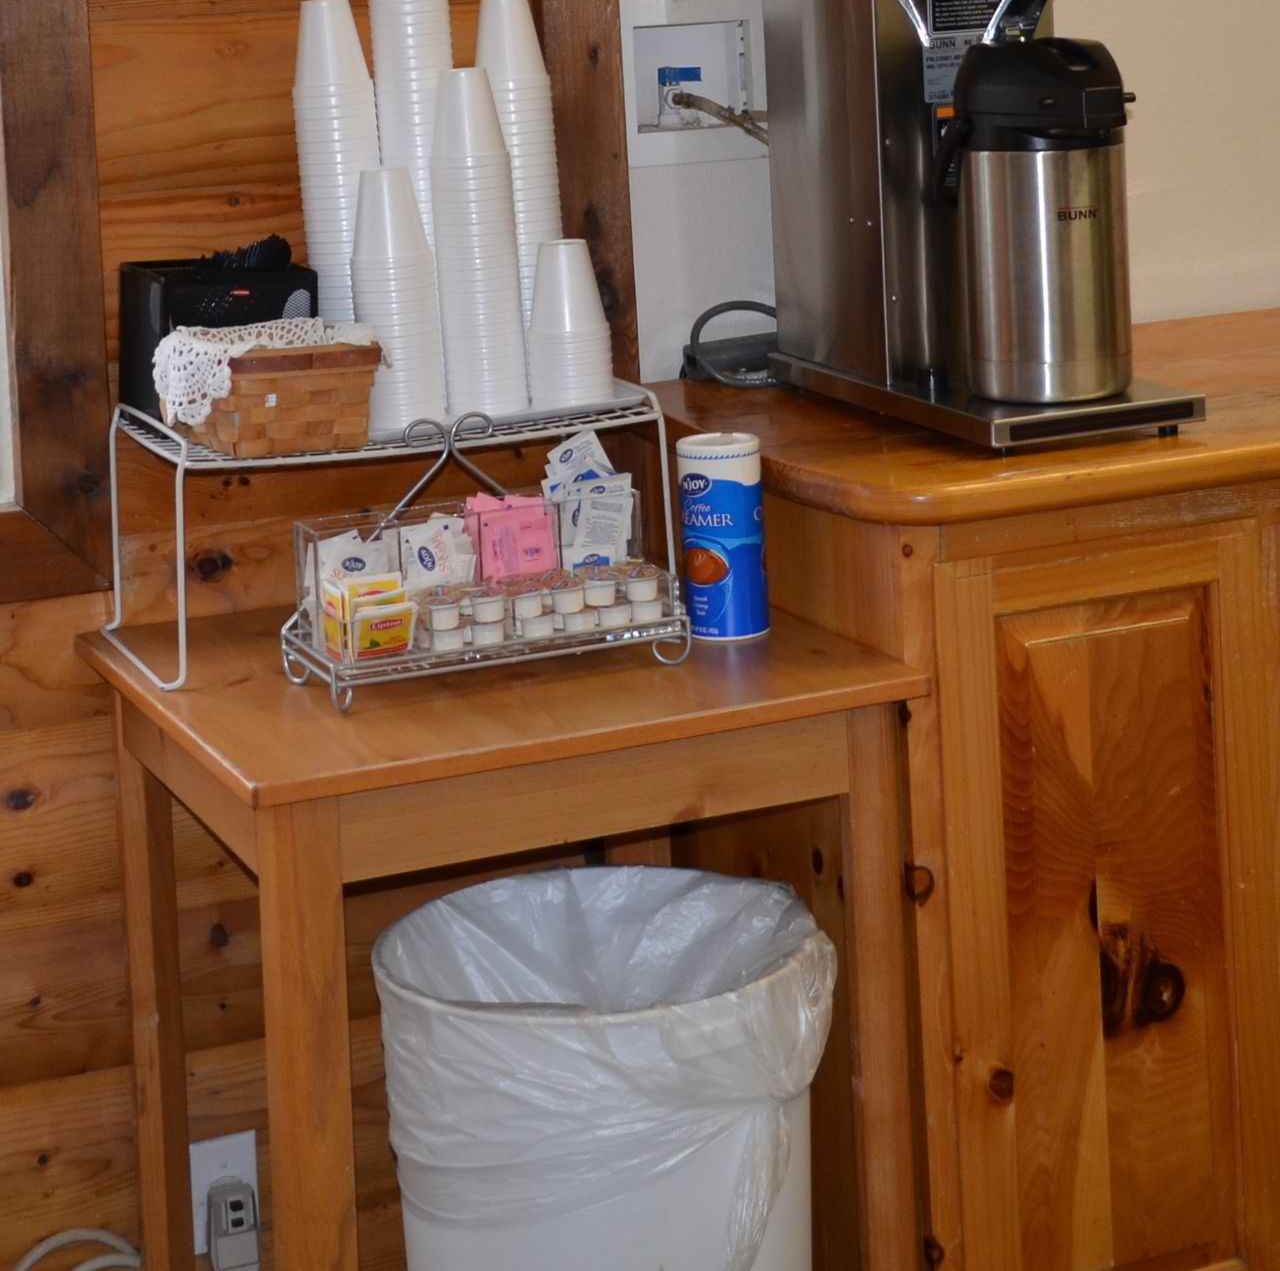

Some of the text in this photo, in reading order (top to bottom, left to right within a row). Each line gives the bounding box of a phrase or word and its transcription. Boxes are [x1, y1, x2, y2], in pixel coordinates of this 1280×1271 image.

[1057, 208, 1097, 222] BUNN
[683, 498, 711, 513] Coffee
[371, 618, 403, 631] Lipton
